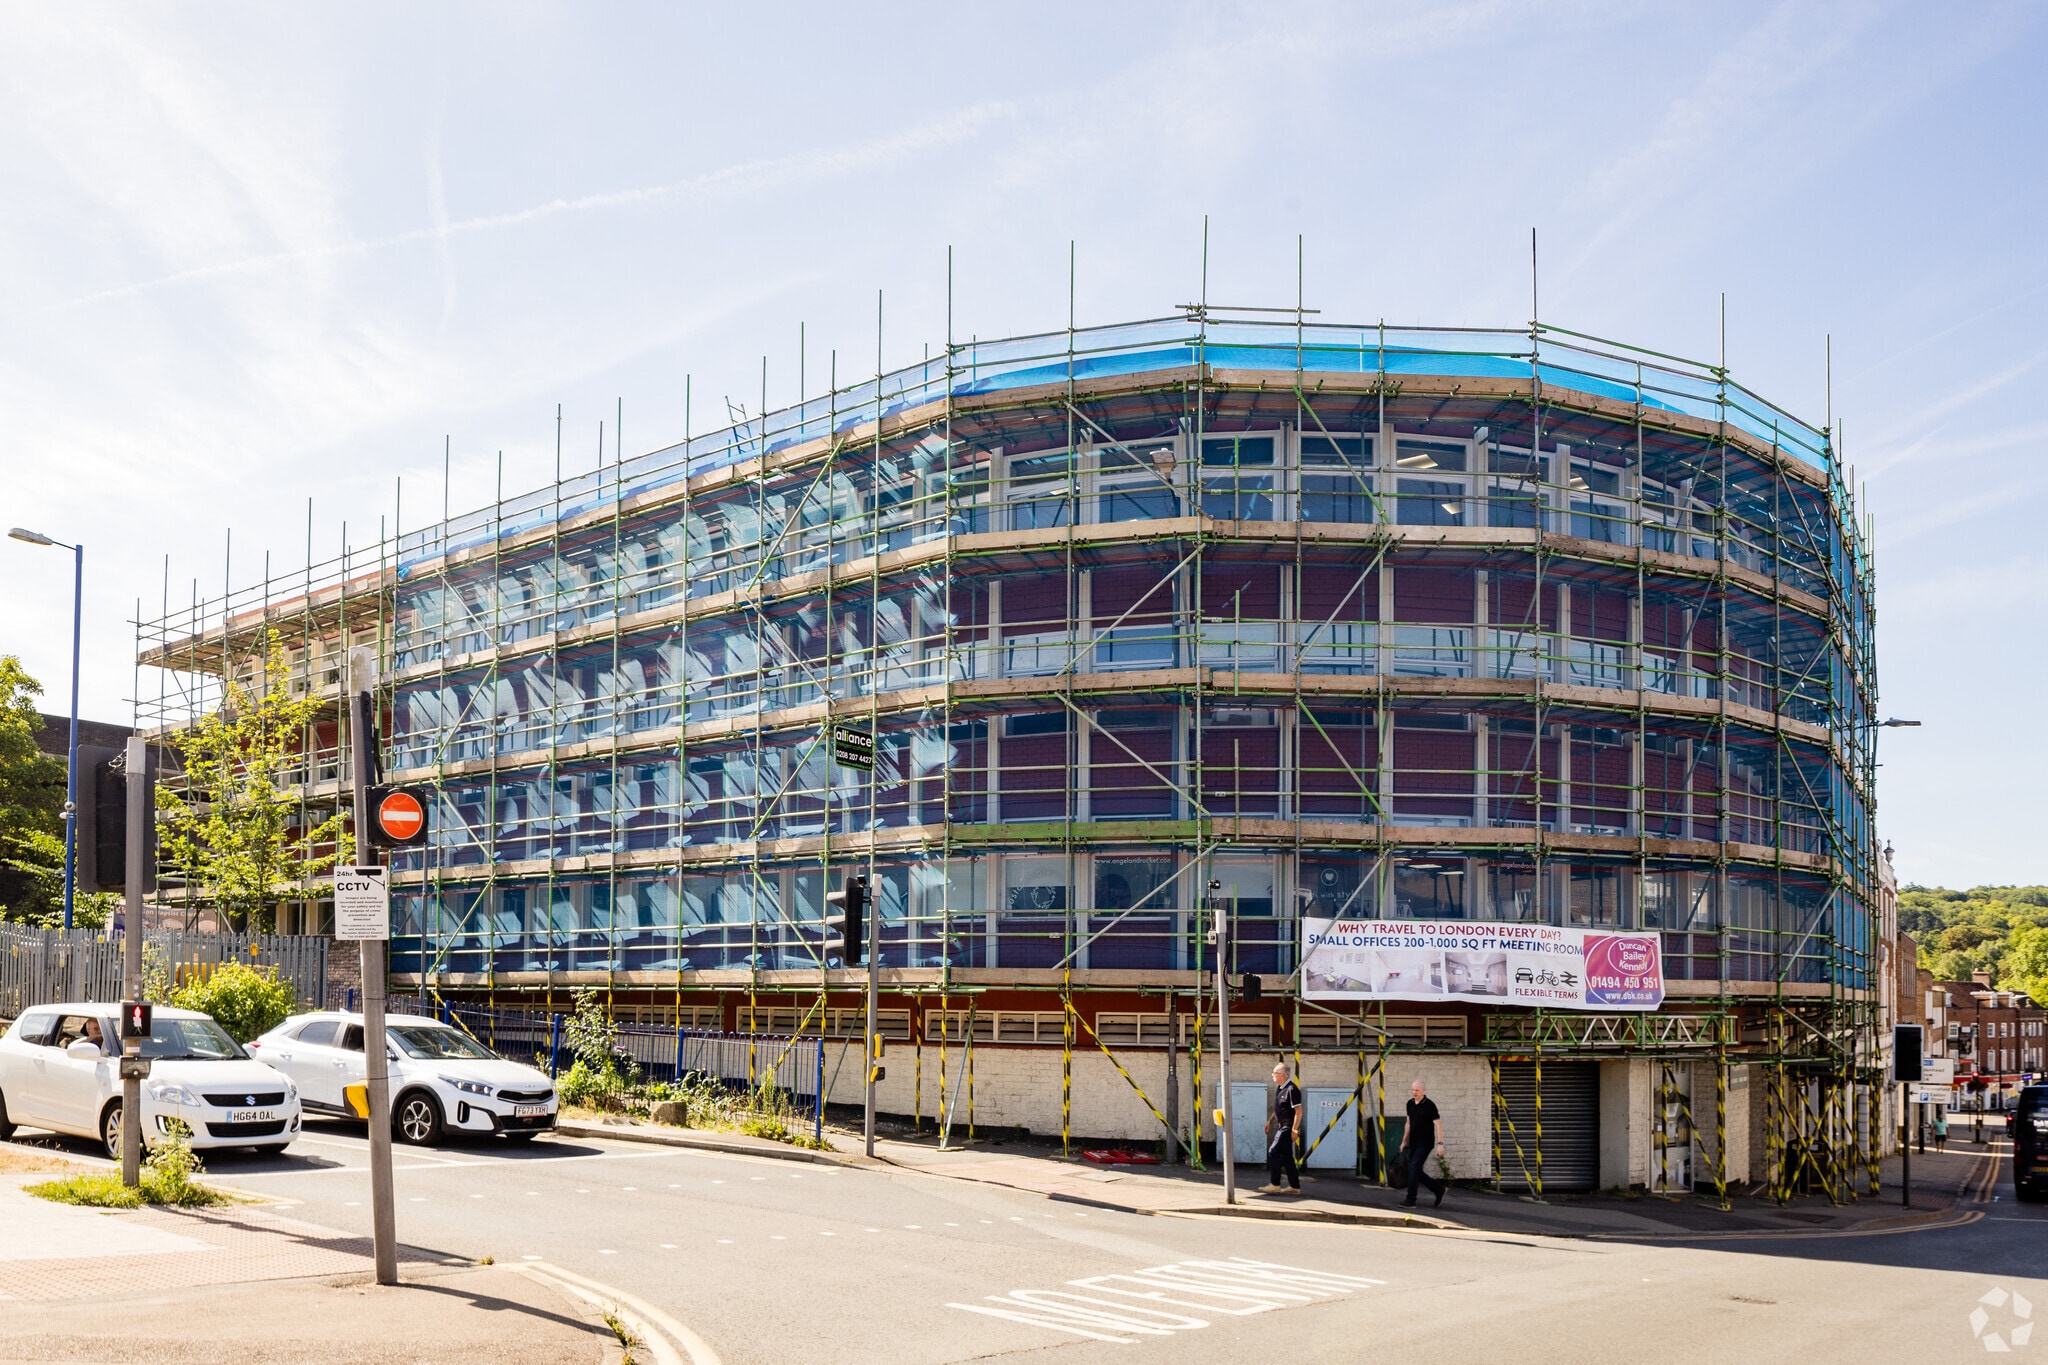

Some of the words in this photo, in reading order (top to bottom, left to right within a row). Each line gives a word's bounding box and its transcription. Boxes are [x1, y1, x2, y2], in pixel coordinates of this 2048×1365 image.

[836, 729, 872, 747] alliance
[849, 752, 858, 761] 207
[859, 754, 872, 764] 4427
[337, 882, 370, 891] CCTV
[1338, 924, 1368, 934] WHY
[1372, 924, 1416, 934] TRAVEL
[1419, 924, 1436, 935] TO
[1440, 925, 1495, 936] LONDON
[1500, 927, 1538, 938] EVERY
[1540, 929, 1561, 940] DAY?
[1308, 934, 1349, 946] SMALL
[1352, 936, 1400, 947] OFFICES
[1462, 938, 1478, 950] SQ
[1482, 939, 1496, 949] FT
[1500, 940, 1551, 952] MEETING
[1554, 944, 1583, 955] ROOM
[1619, 942, 1646, 952] Duncan
[1623, 951, 1646, 962] Bailey
[1619, 960, 1647, 971] Kennedy
[1592, 976, 1620, 988] 01494
[1624, 977, 1640, 988] 450
[1642, 977, 1658, 988] 951
[1515, 988, 1552, 998] FLEXIBLE
[1554, 991, 1578, 999] TERMS
[1605, 991, 1653, 1000] www.dbk.co.uk
[233, 1111, 257, 1120] HG64
[259, 1111, 276, 1120] OAL
